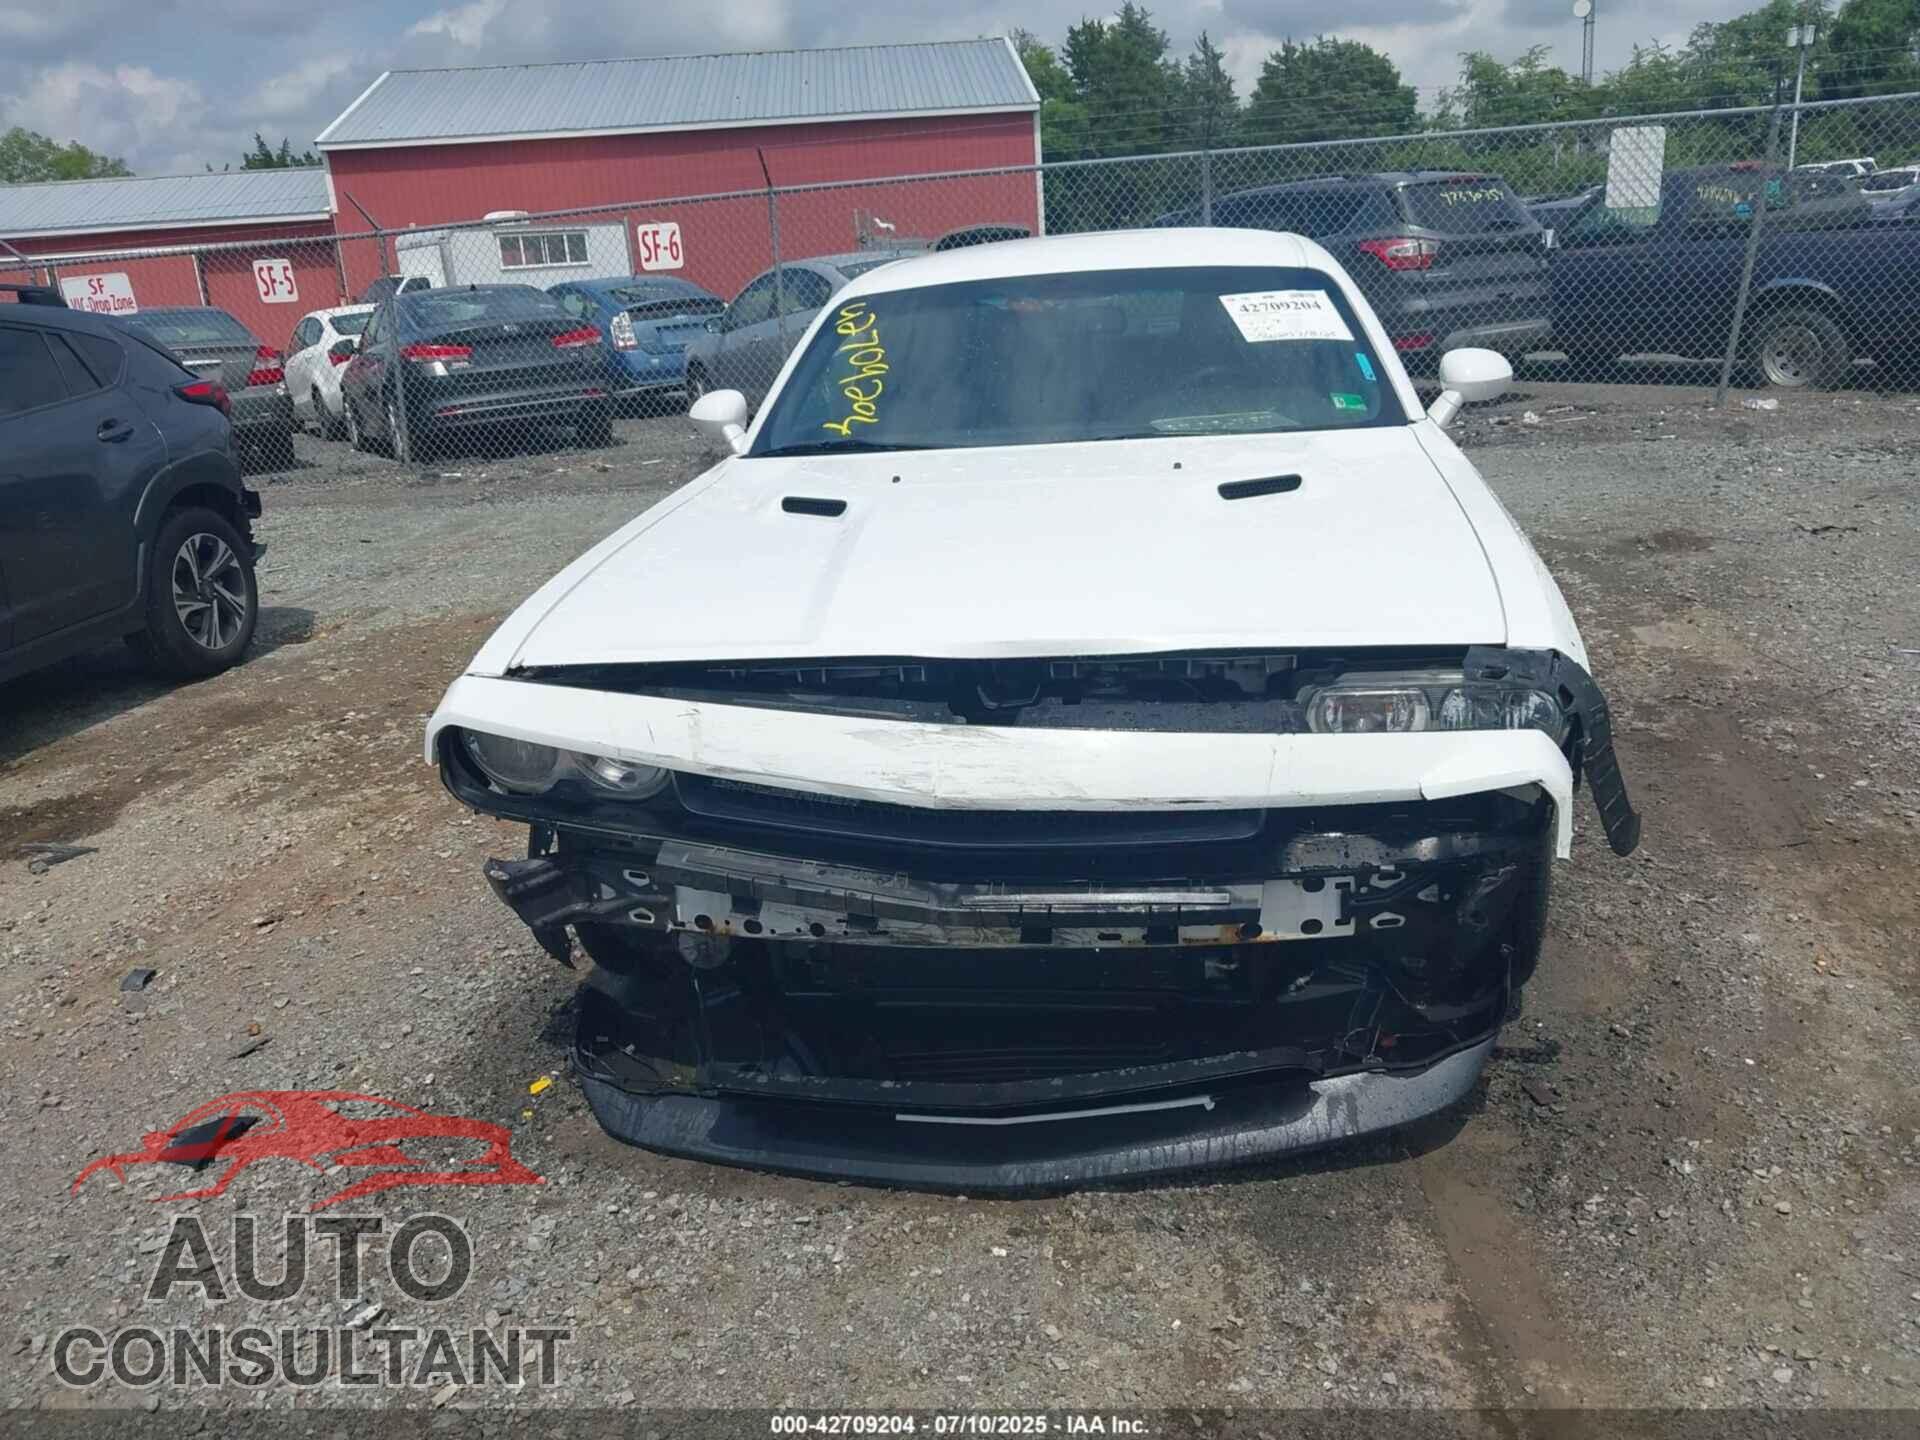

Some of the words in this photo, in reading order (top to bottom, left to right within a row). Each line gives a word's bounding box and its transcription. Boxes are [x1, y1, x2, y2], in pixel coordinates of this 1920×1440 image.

[641, 230, 680, 262] SF-6
[88, 278, 104, 295] SF
[258, 265, 294, 296] SF-5
[110, 293, 135, 311] Zone
[1239, 300, 1322, 313] 42709204
[822, 301, 889, 436] 42709204
